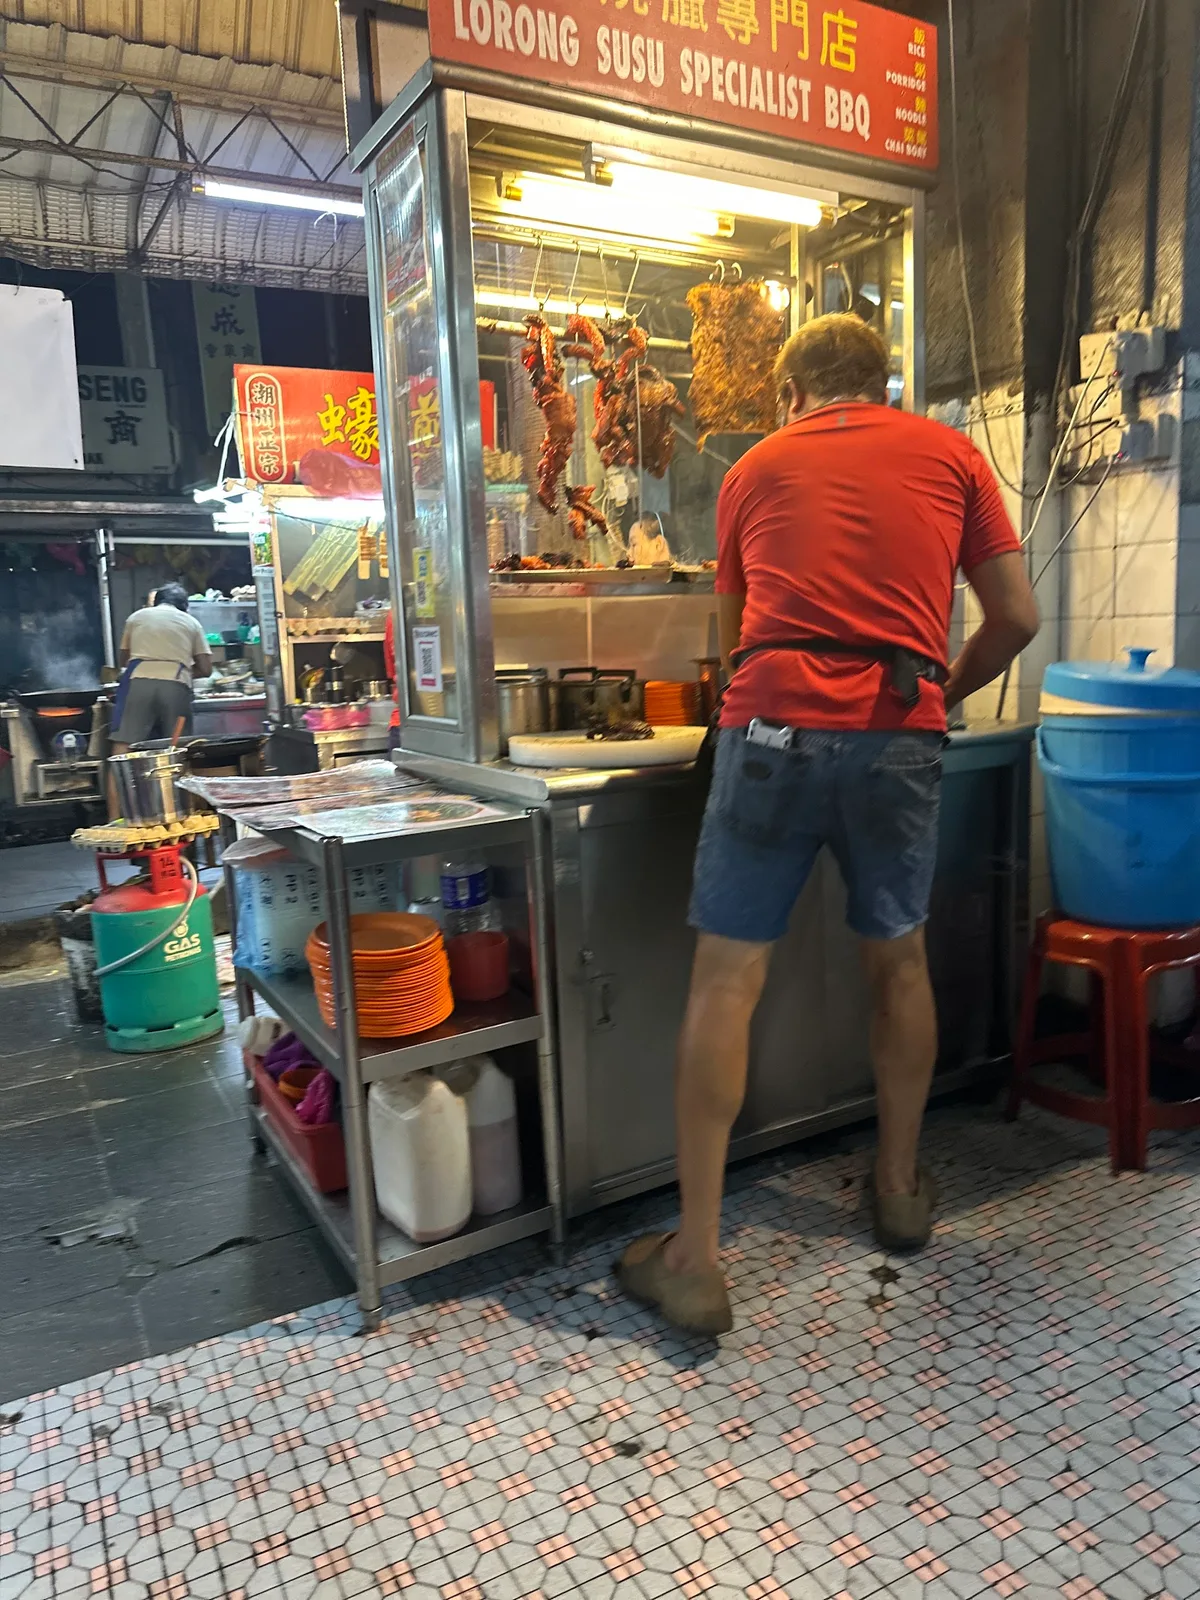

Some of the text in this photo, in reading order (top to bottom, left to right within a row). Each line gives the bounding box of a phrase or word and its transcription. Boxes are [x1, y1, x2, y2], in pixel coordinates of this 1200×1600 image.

[907, 41, 926, 58] RICE
[453, 0, 871, 142] LORONG SUSU SPECIALIST BBQ
[885, 69, 927, 92] PORRIDGE
[895, 106, 927, 126] NOODLE
[79, 374, 147, 402] SENG
[103, 409, 143, 446] 商
[252, 381, 280, 476] 潮州正宗
[164, 934, 201, 954] GAS
